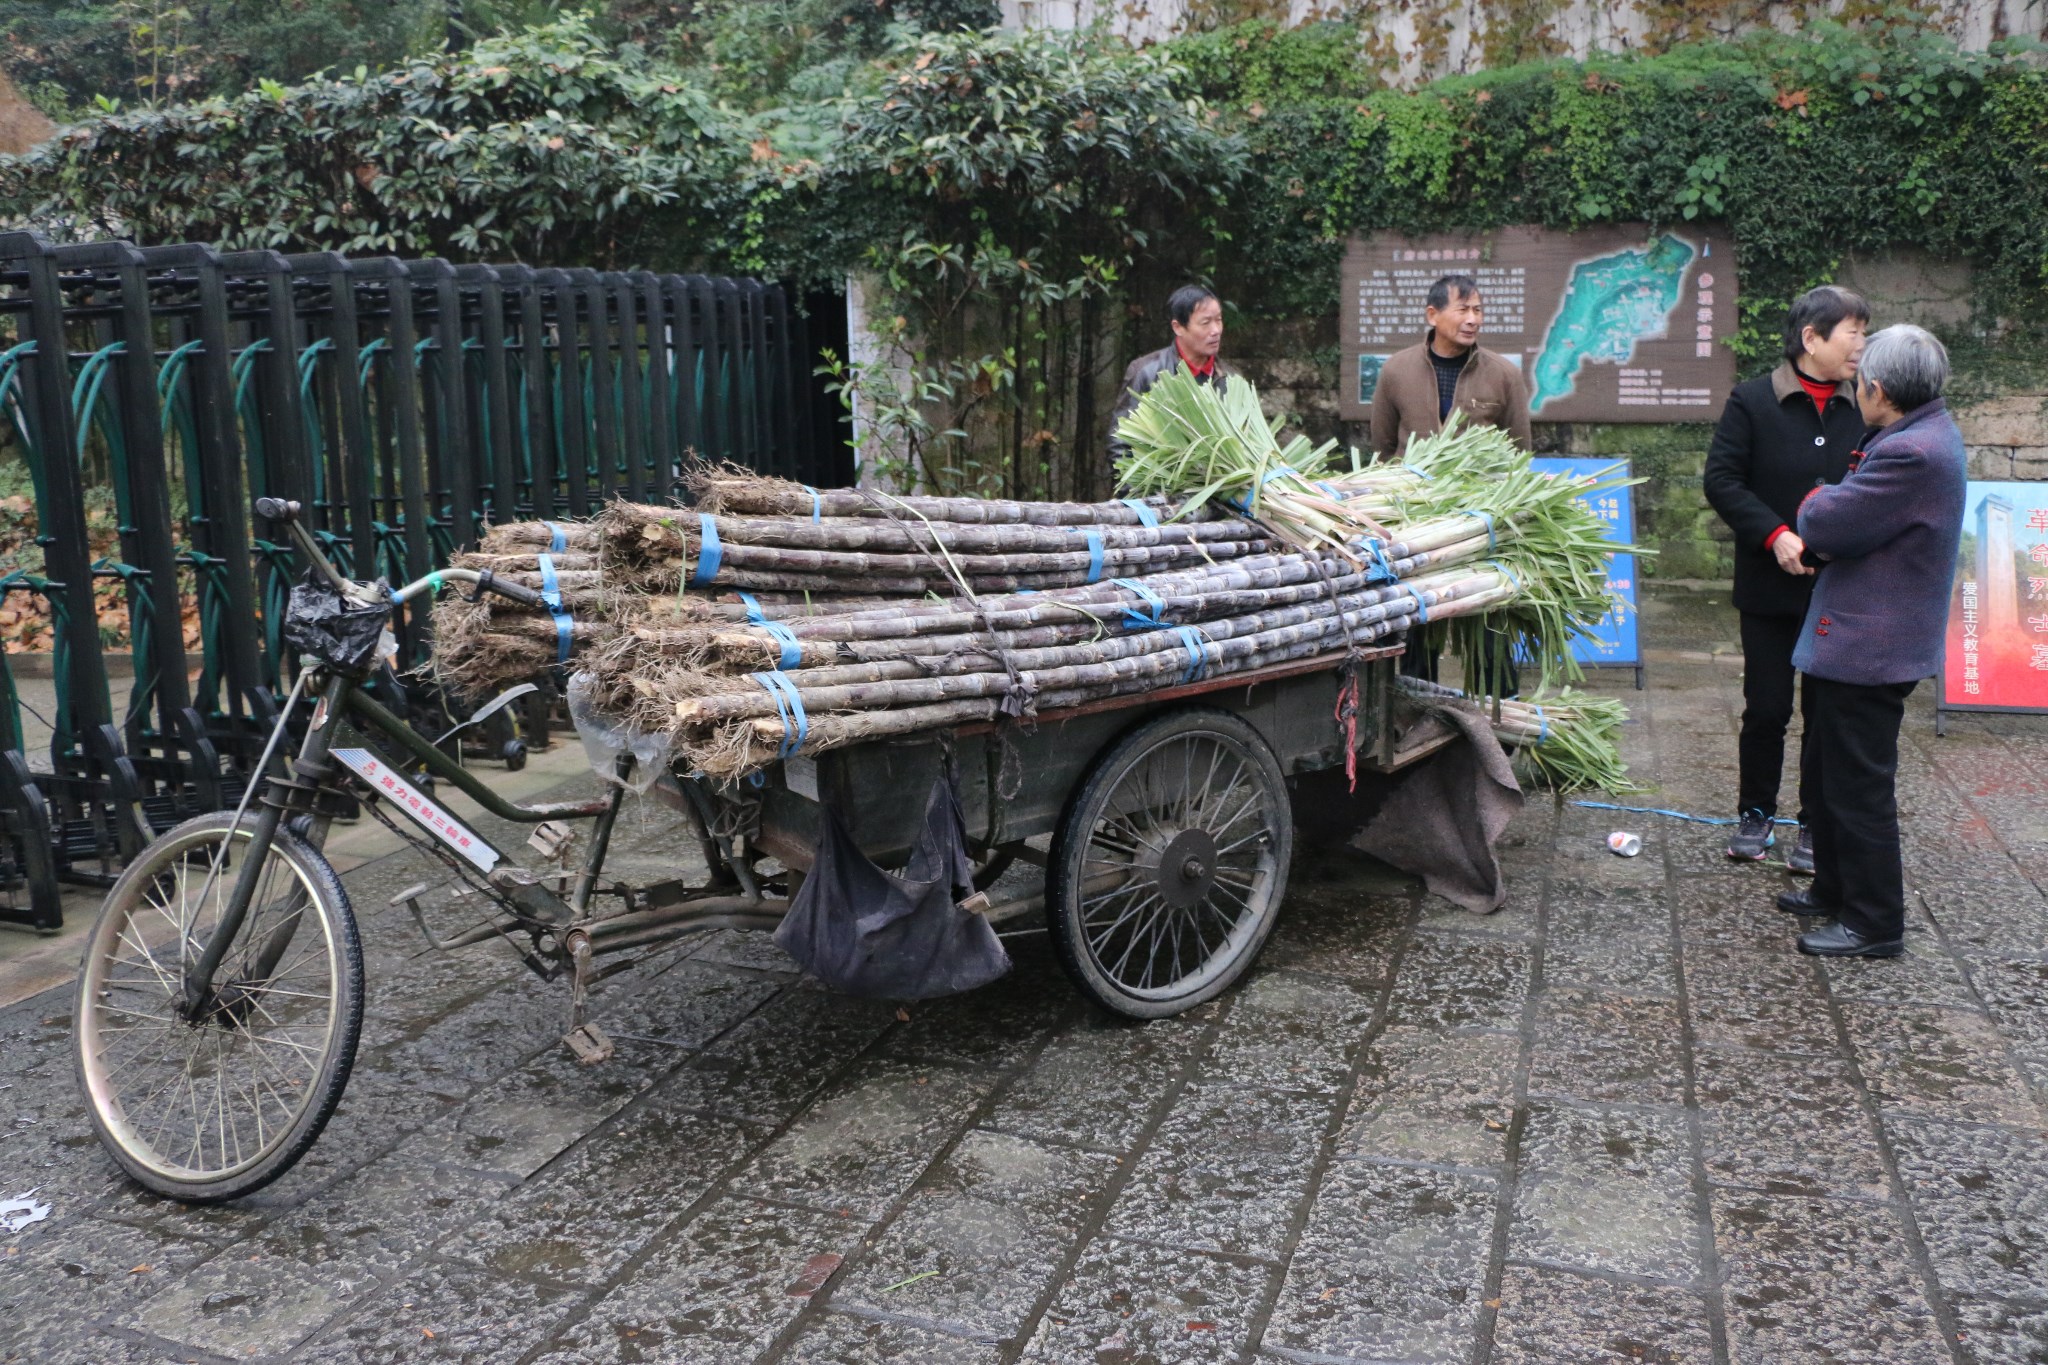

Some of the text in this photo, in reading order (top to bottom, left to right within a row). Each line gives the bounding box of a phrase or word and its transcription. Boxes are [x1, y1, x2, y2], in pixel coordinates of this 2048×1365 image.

[1962, 582, 1980, 695] 爱国主义教育基地
